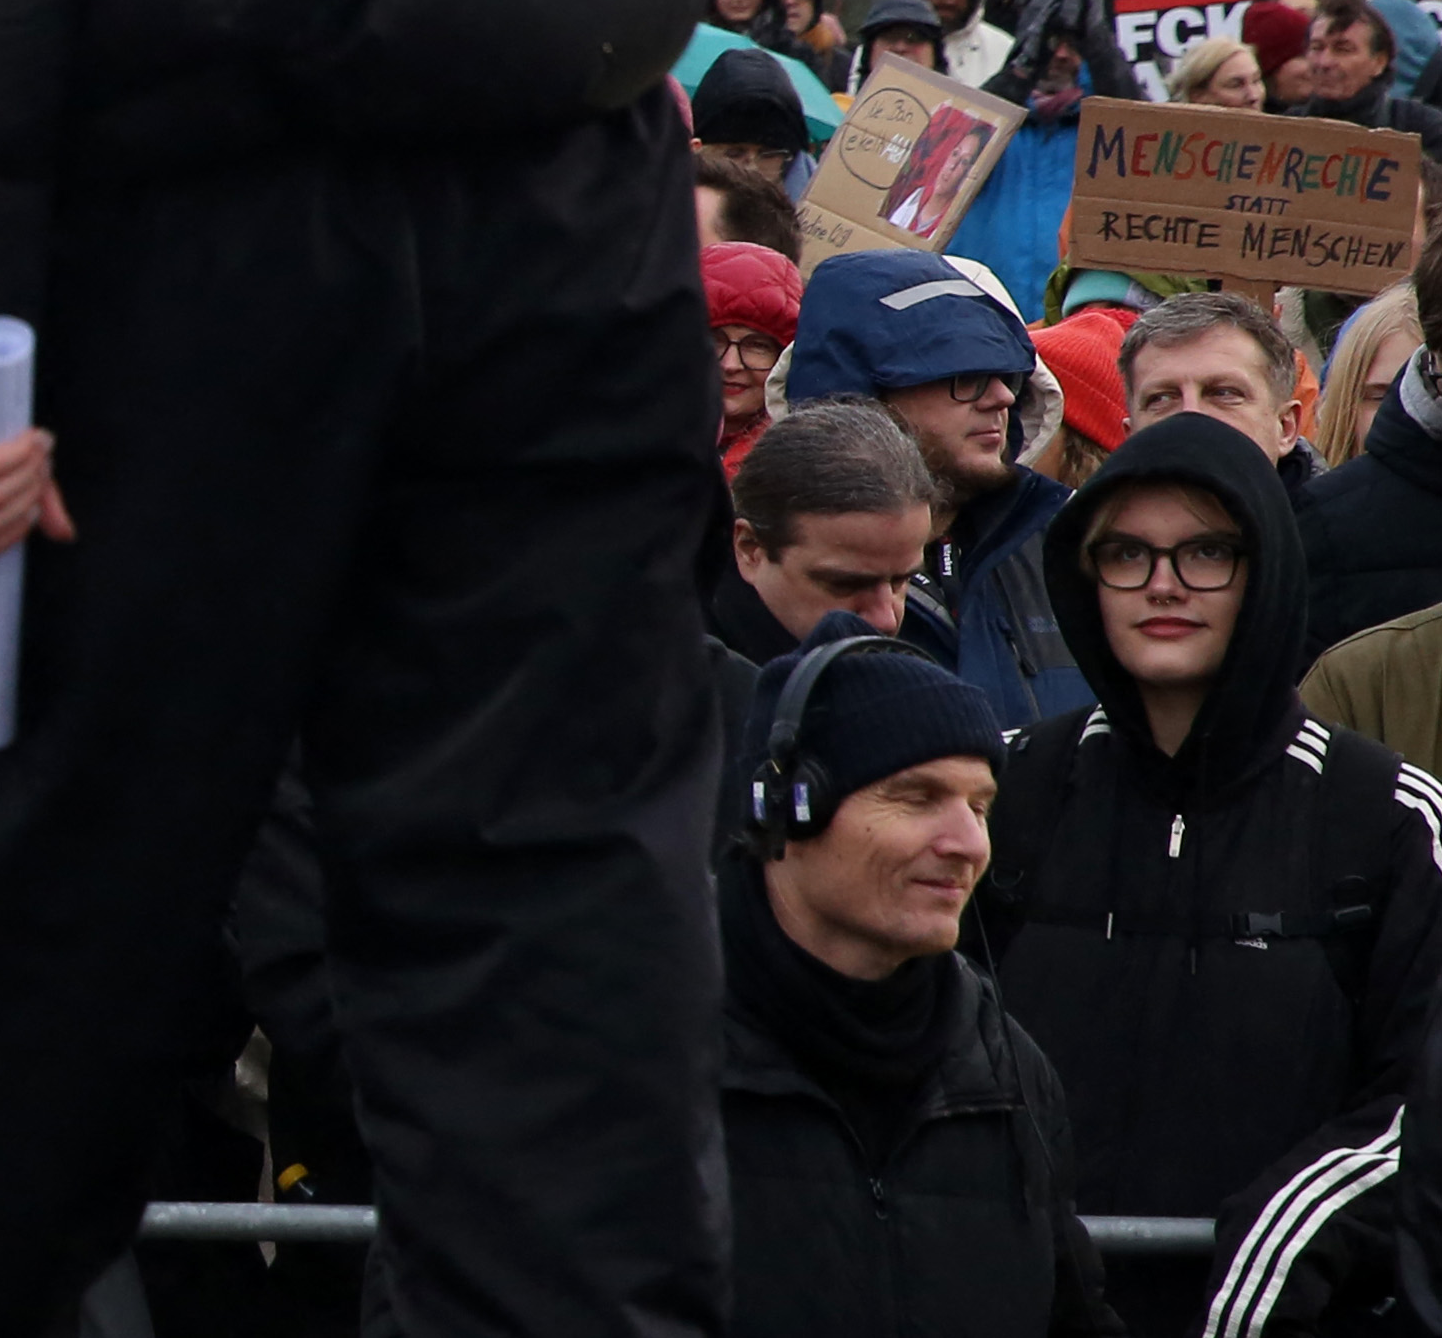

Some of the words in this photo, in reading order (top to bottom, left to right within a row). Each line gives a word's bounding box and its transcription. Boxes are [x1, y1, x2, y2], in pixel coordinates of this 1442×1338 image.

[1087, 124, 1399, 204] MENSCHENRECHTE
[1225, 195, 1291, 215] STATT
[1097, 211, 1221, 249] RECHTE
[1241, 220, 1407, 268] MENSCHEN
